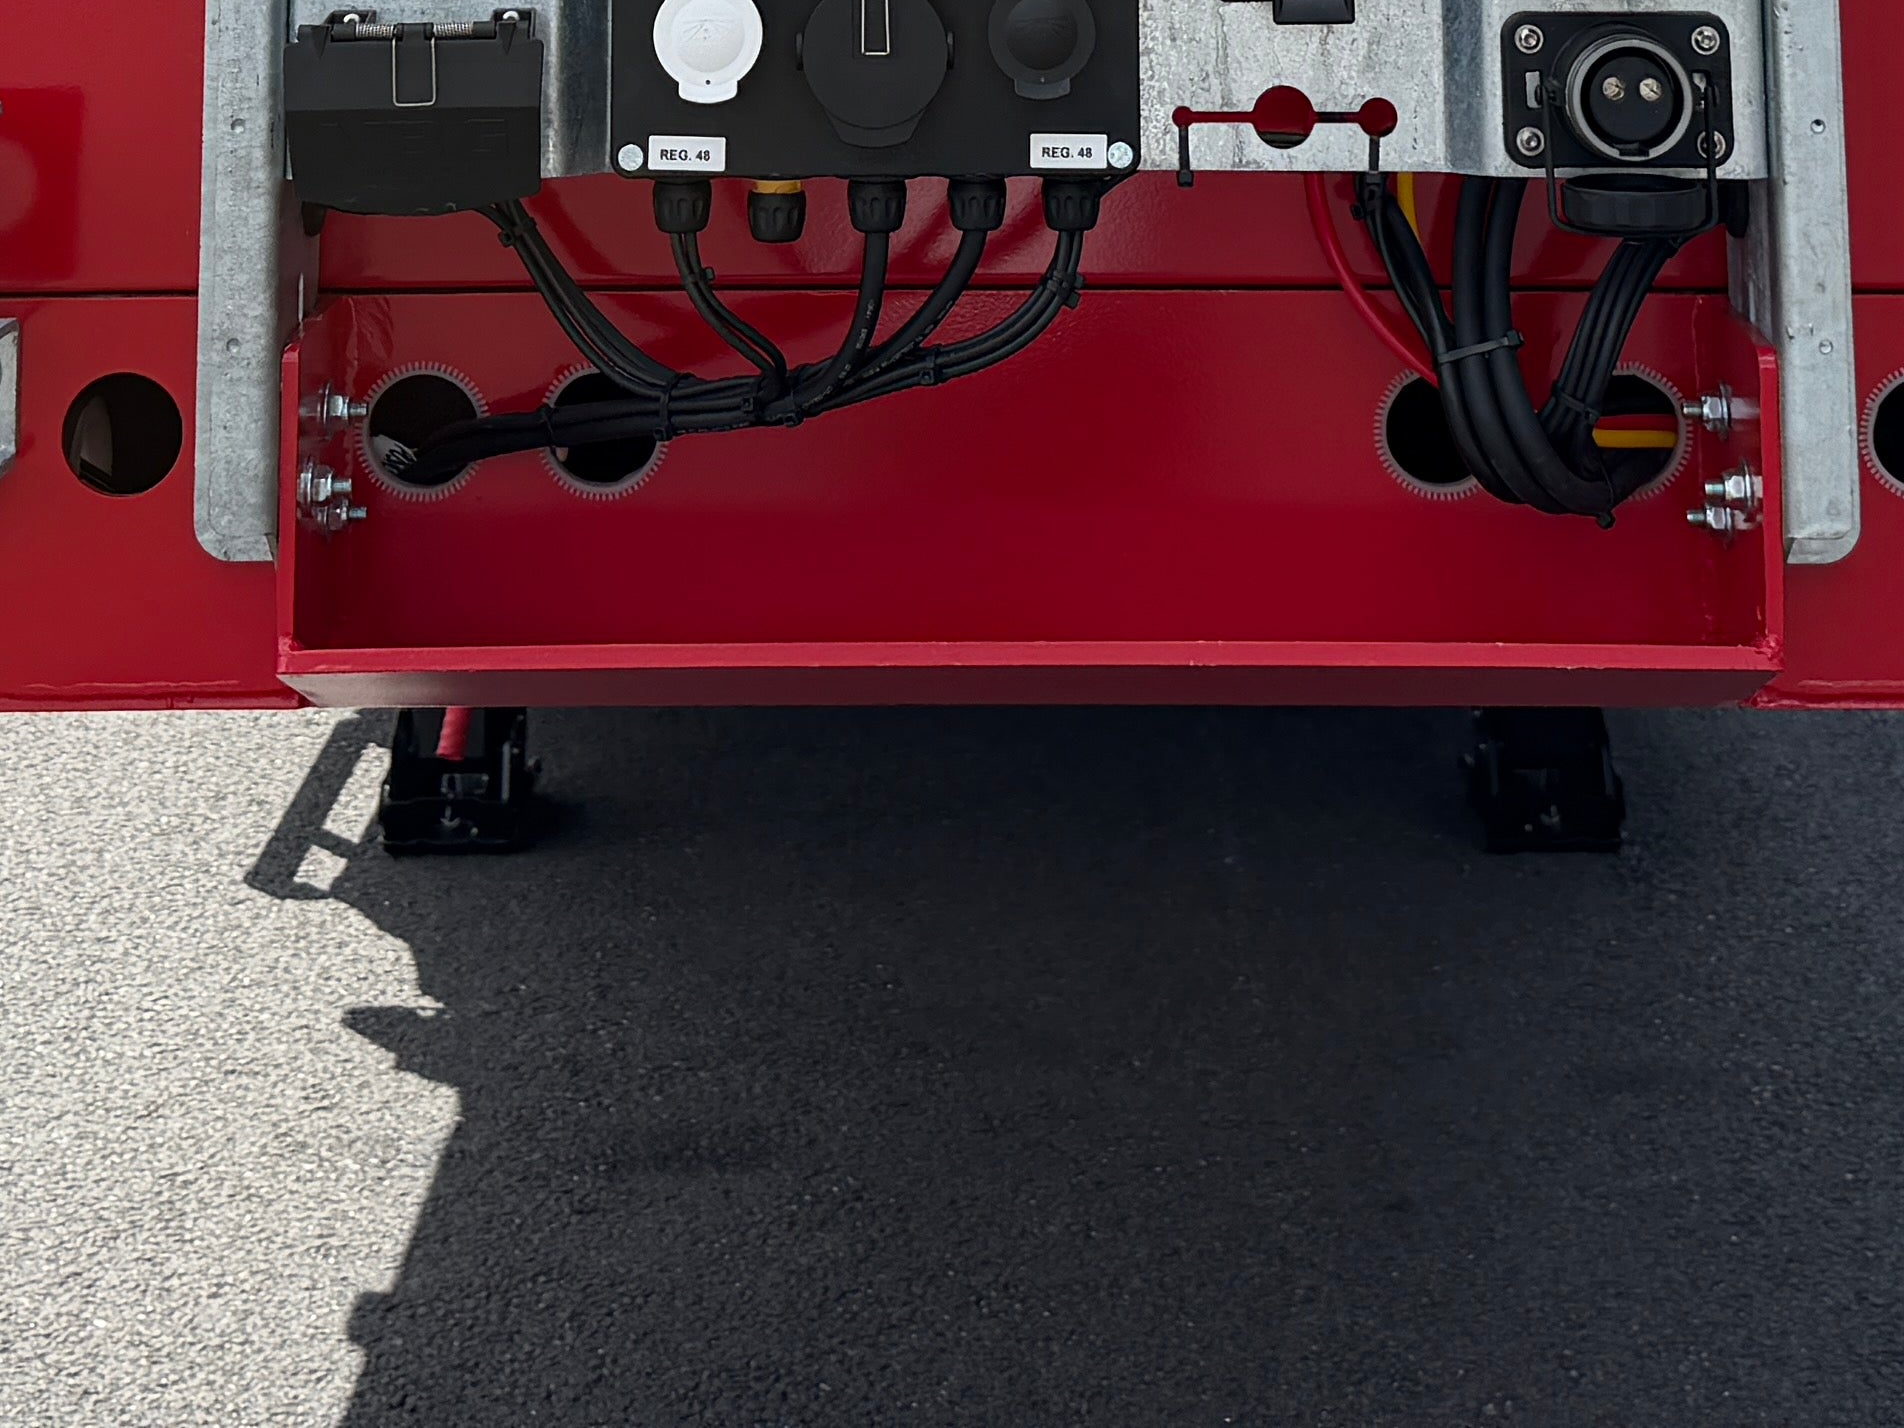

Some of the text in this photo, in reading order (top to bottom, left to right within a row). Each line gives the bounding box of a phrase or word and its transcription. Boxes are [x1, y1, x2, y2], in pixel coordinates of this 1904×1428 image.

[659, 149, 710, 161] REG. 48
[1042, 146, 1093, 159] REG. 48
